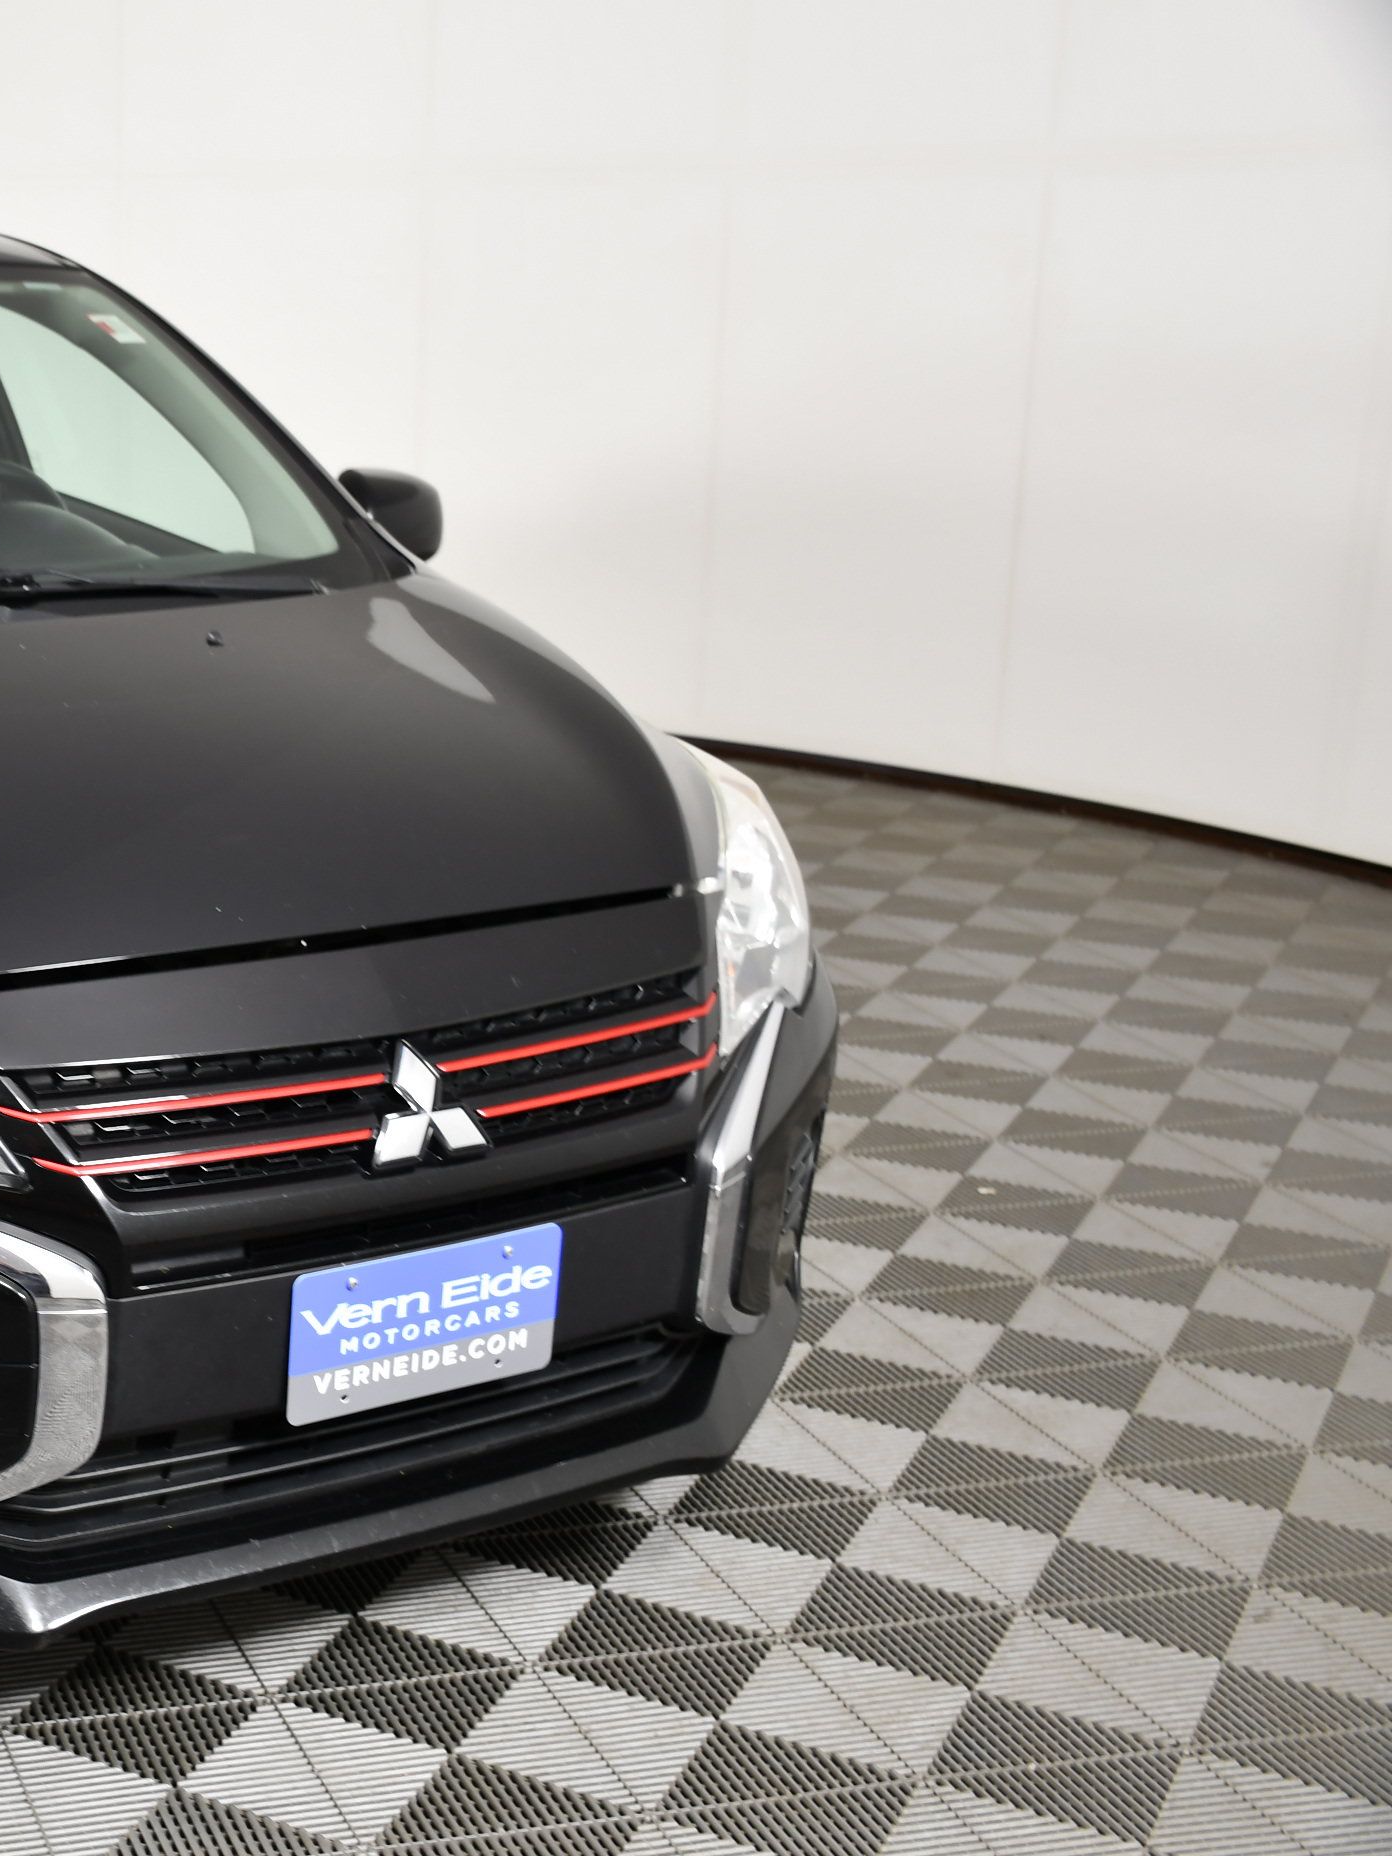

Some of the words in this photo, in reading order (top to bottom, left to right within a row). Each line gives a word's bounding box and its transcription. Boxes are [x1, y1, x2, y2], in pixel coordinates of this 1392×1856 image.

[300, 1290, 430, 1336] Vern
[440, 1264, 553, 1309] Eide
[338, 1301, 520, 1355] MOTORCARS
[313, 1328, 528, 1394] VERNEIDE.COM
